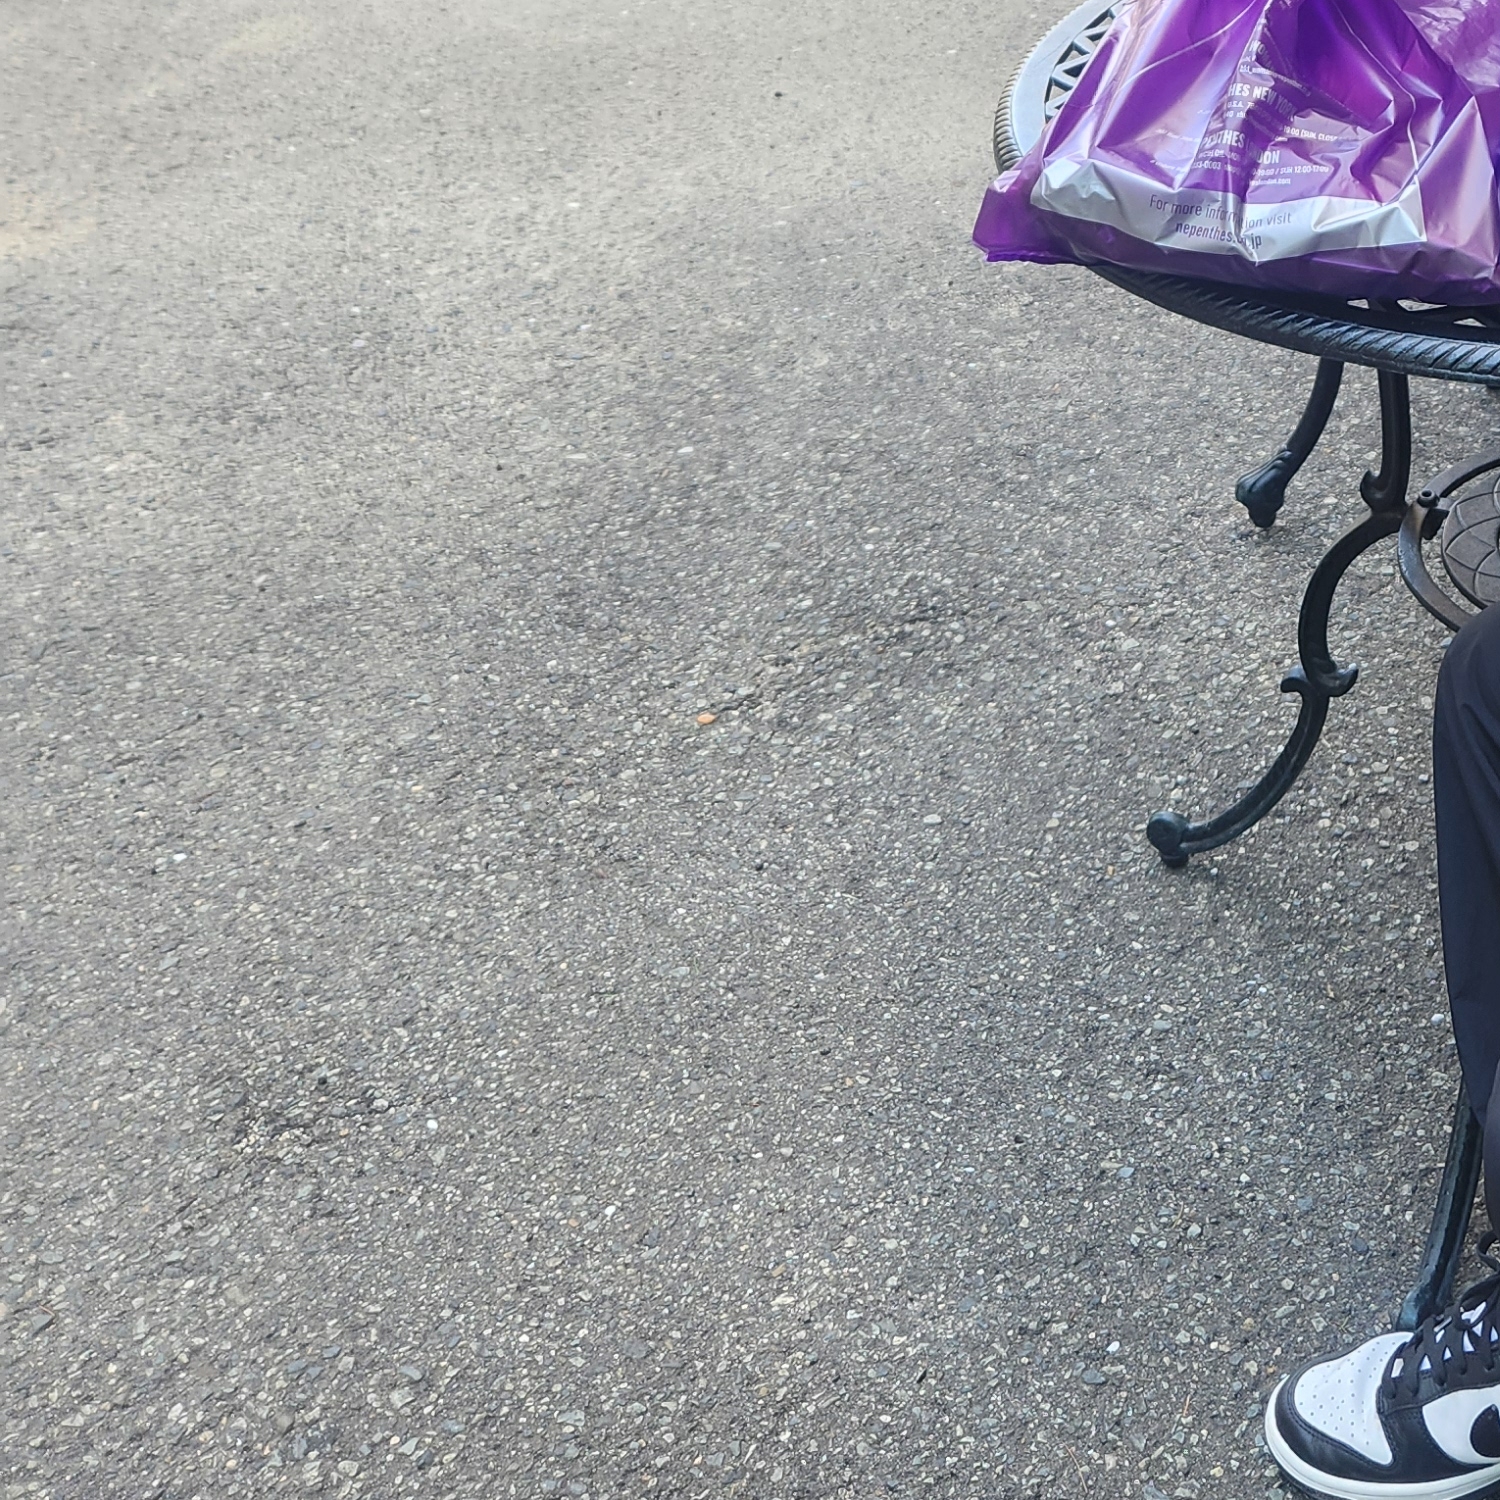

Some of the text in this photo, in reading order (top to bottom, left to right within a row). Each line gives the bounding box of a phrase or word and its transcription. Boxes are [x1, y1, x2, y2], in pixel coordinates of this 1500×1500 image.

[1252, 85, 1278, 106] NEW
[1150, 194, 1292, 228] For more informtion visit
